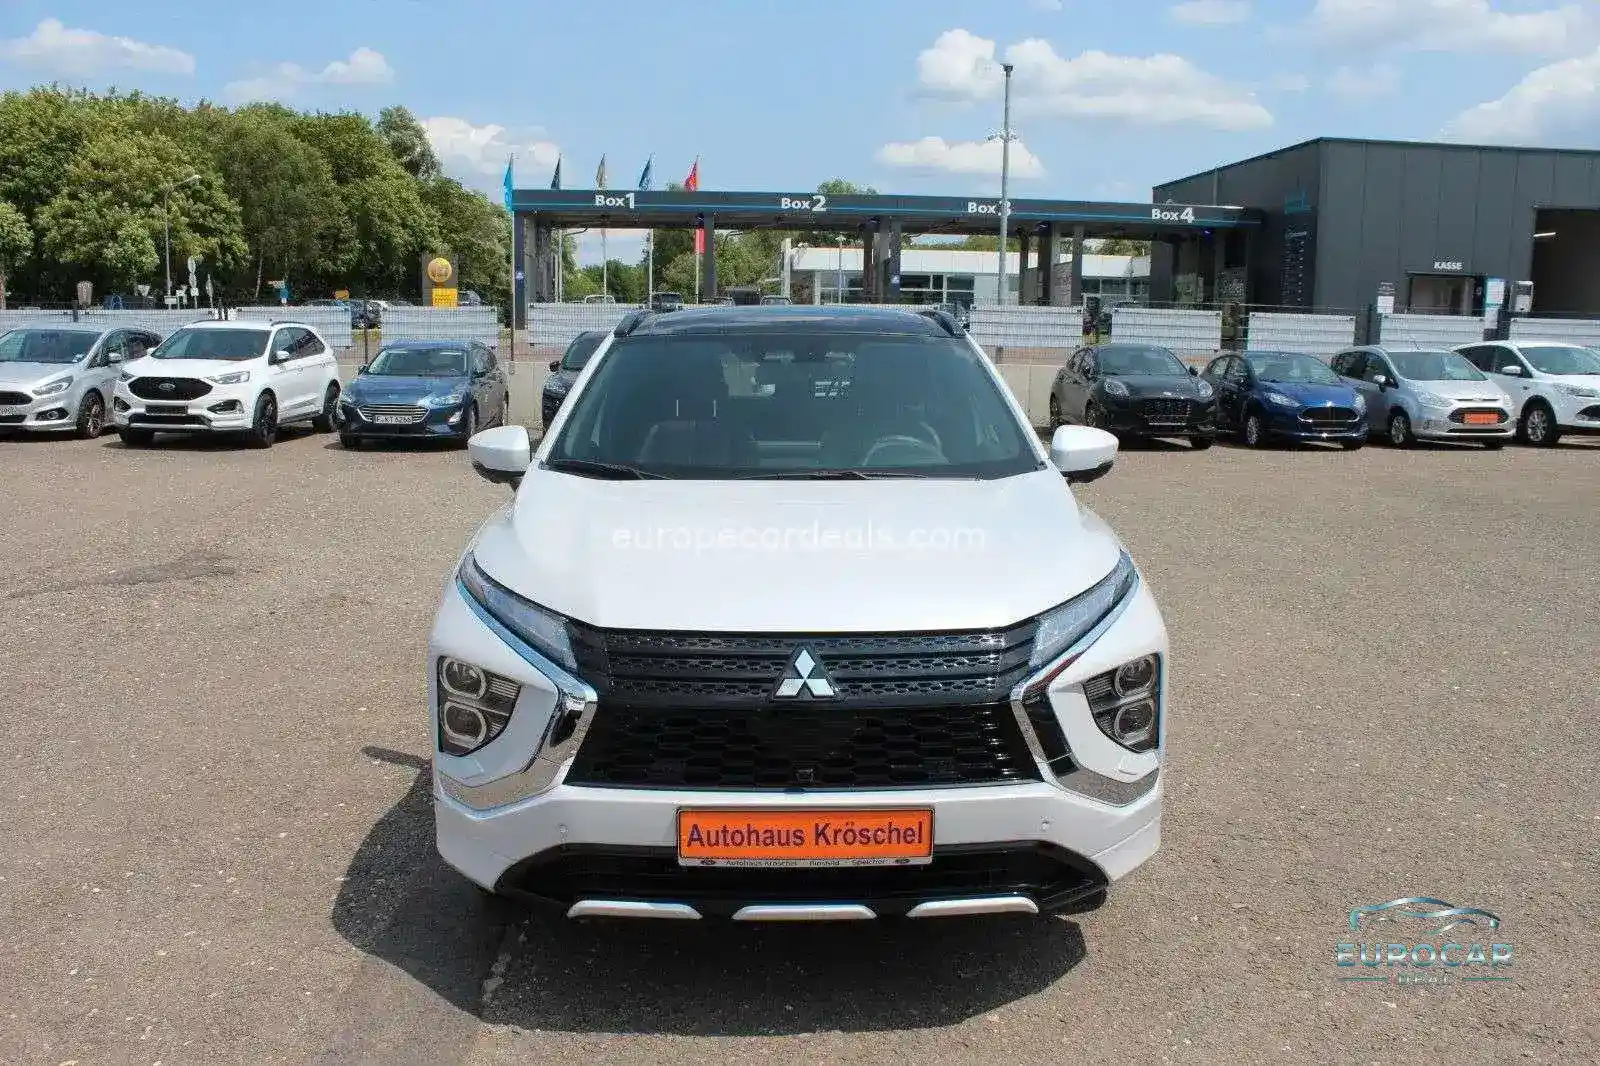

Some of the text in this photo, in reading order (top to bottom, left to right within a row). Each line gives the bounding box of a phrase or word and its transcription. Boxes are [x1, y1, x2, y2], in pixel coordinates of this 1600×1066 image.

[1433, 261, 1463, 270] KASSE
[686, 821, 924, 847] Autohaus Kröschel
